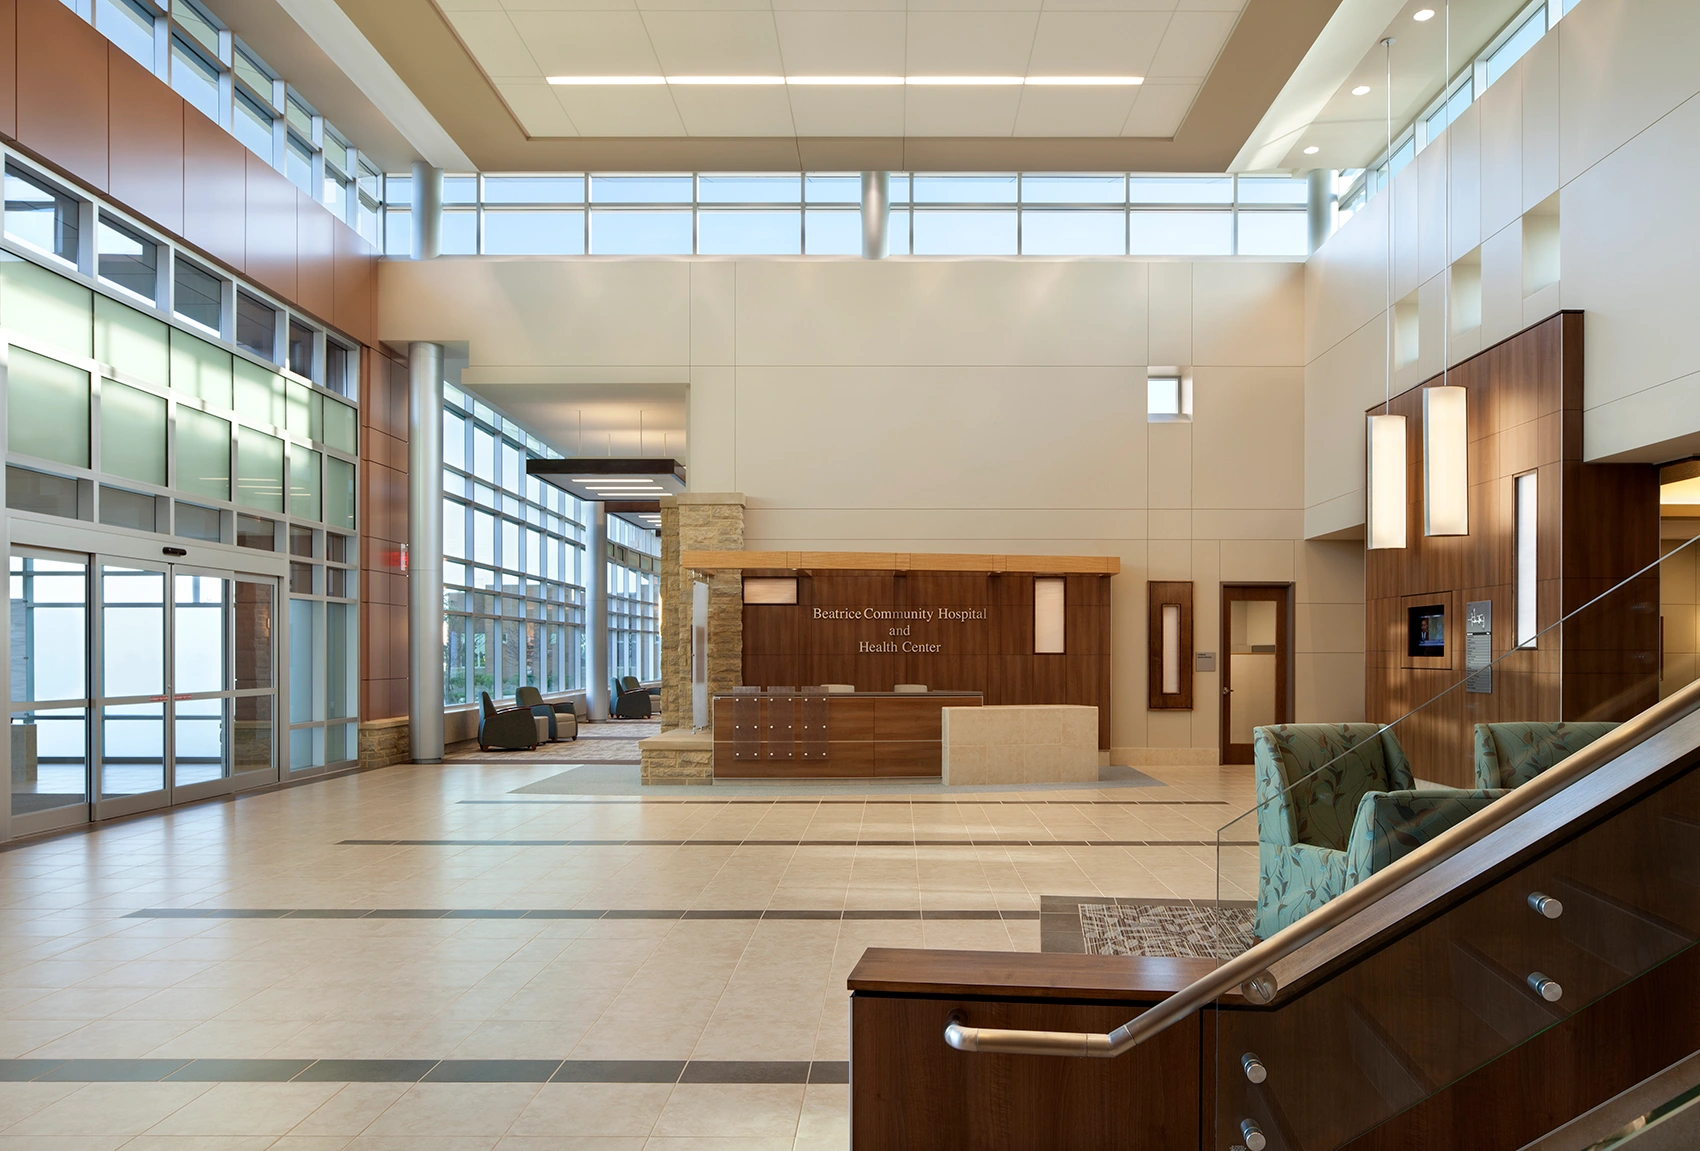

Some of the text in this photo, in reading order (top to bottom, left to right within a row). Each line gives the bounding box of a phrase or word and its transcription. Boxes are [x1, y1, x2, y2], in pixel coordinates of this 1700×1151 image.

[813, 608, 987, 622] Beatrice Community Hospital
[889, 625, 911, 636] and
[859, 641, 942, 653] Health Center
